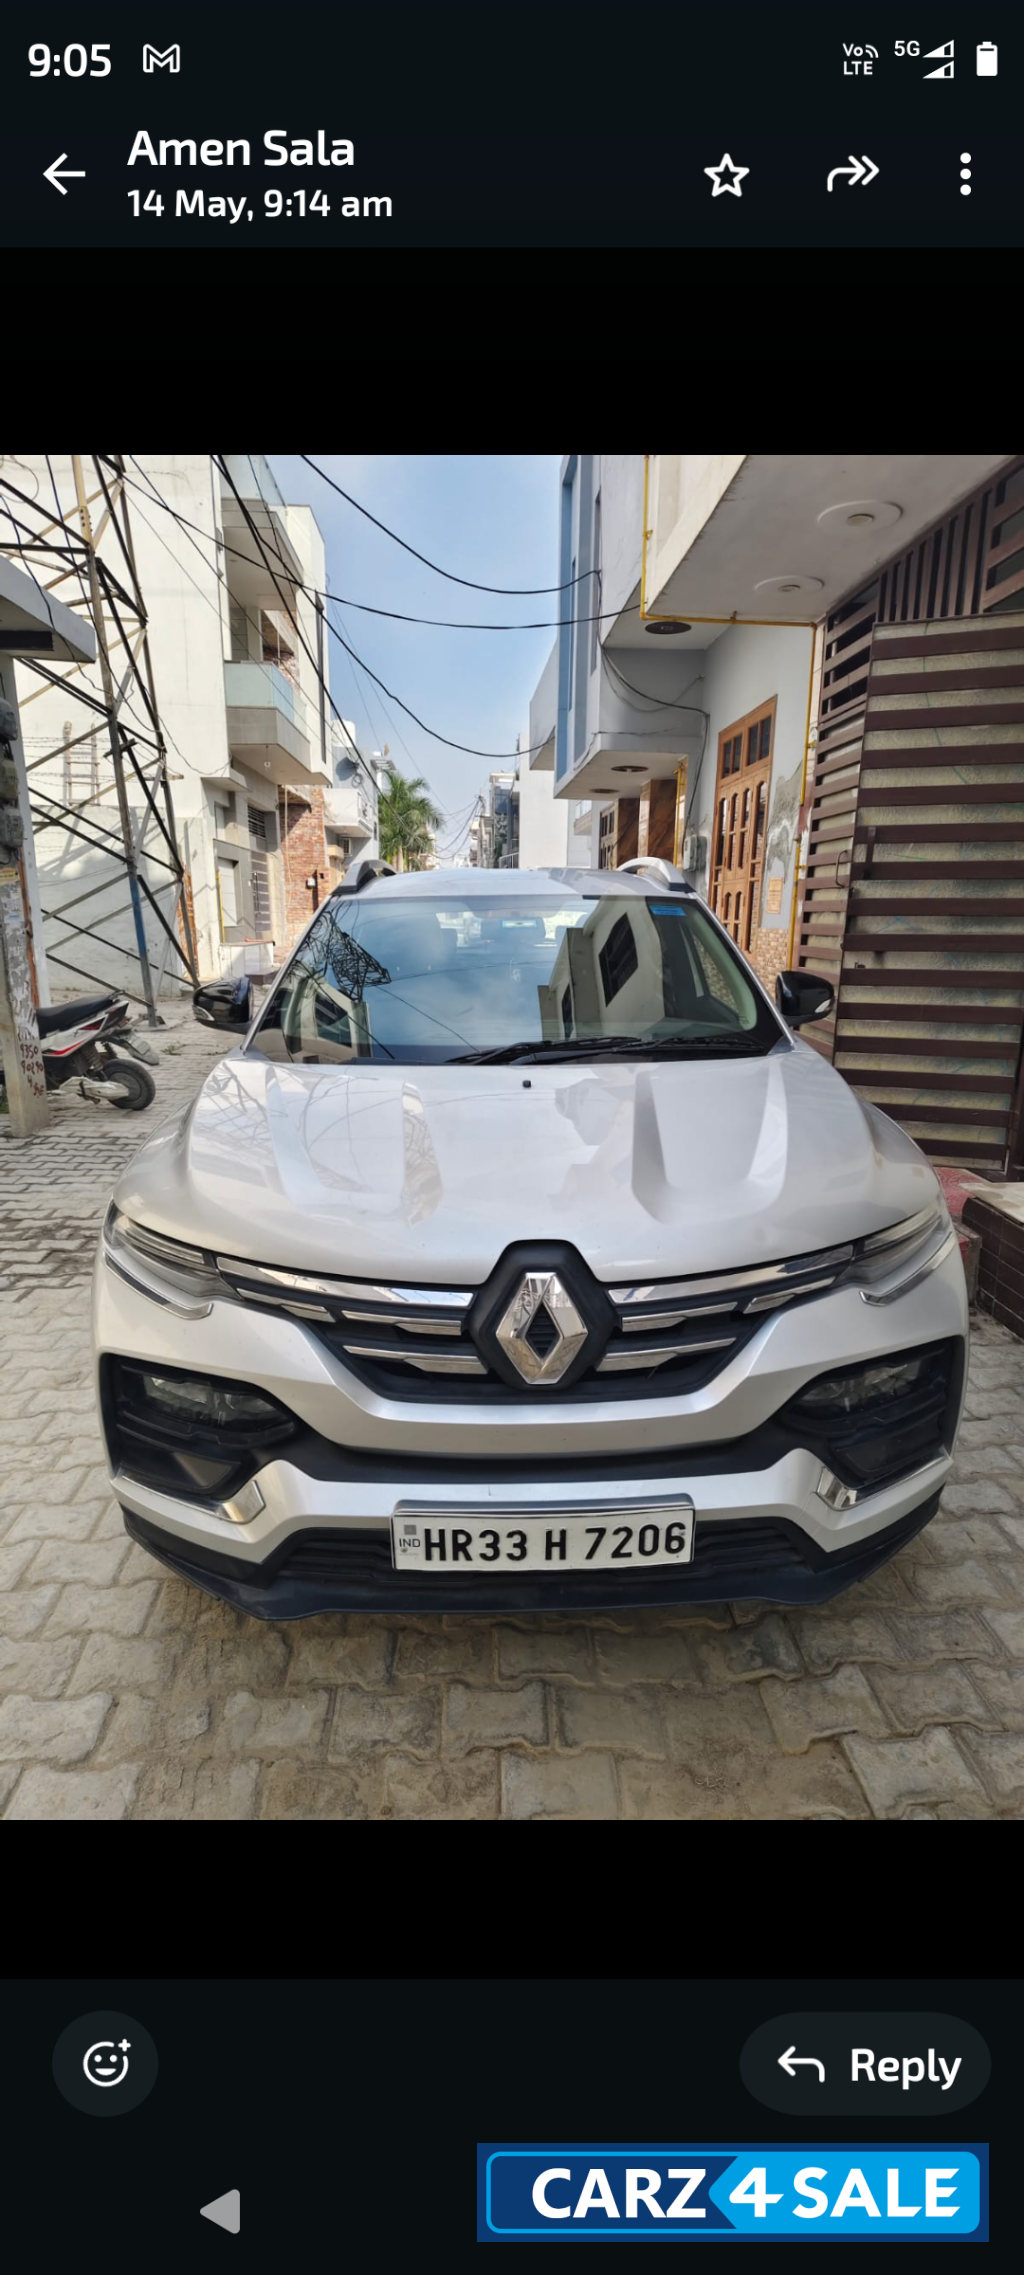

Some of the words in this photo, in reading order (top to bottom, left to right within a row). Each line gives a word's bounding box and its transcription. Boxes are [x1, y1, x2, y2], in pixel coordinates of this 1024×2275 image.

[28, 43, 112, 78] 9:05
[894, 40, 920, 57] 5G
[843, 60, 873, 76] LTE
[127, 130, 251, 167] Amen
[263, 129, 355, 167] Sala
[127, 189, 165, 217] 14
[175, 189, 254, 225] May,
[263, 189, 331, 218] 9:14
[341, 196, 393, 218] am
[399, 1538, 421, 1548] IND
[424, 1528, 528, 1562] HR33
[545, 1528, 567, 1561] H
[585, 1522, 688, 1560] 7206
[851, 2048, 963, 2091] Reply
